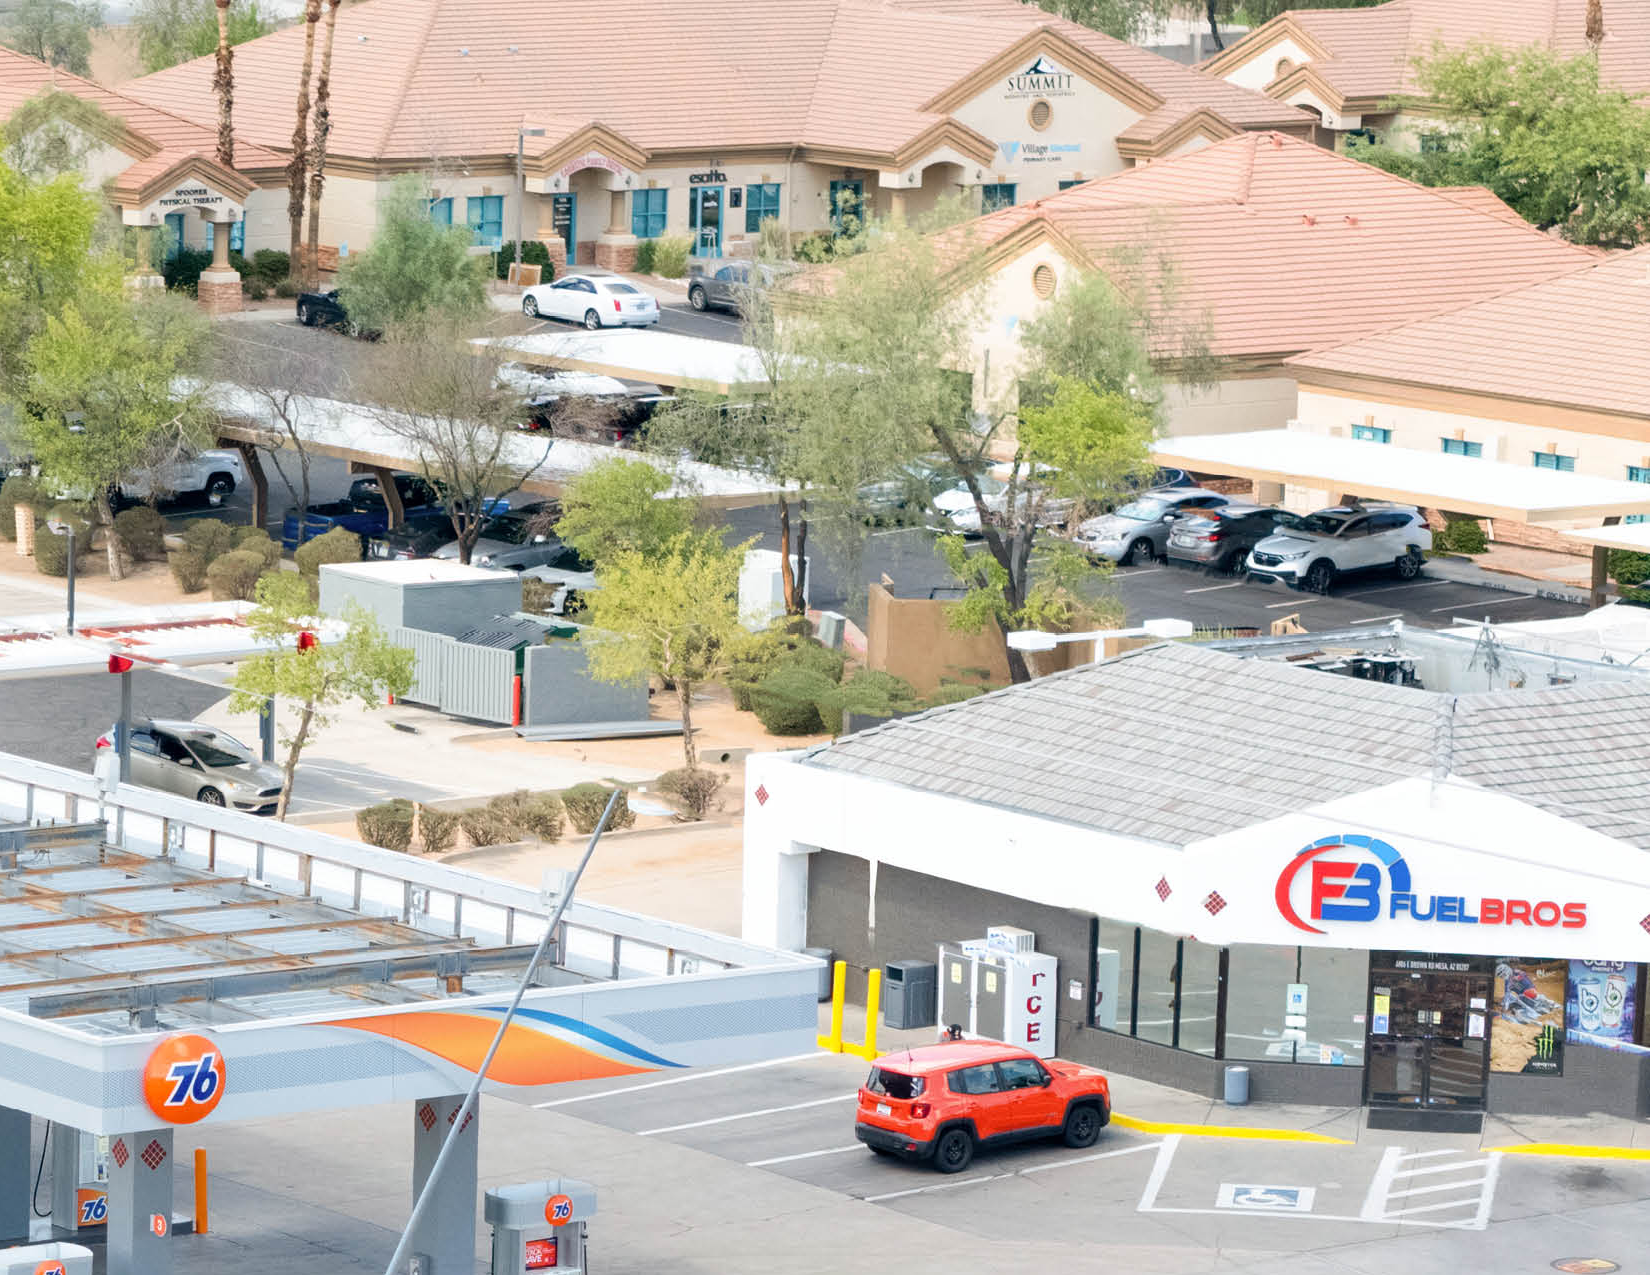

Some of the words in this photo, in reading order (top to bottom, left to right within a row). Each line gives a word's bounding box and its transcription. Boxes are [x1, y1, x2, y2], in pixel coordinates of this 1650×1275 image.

[1007, 75, 1074, 91] SUMMIT
[1022, 143, 1048, 155] Village
[164, 1052, 219, 1106] 76
[81, 1196, 108, 1223] 76
[552, 1201, 570, 1219] 76
